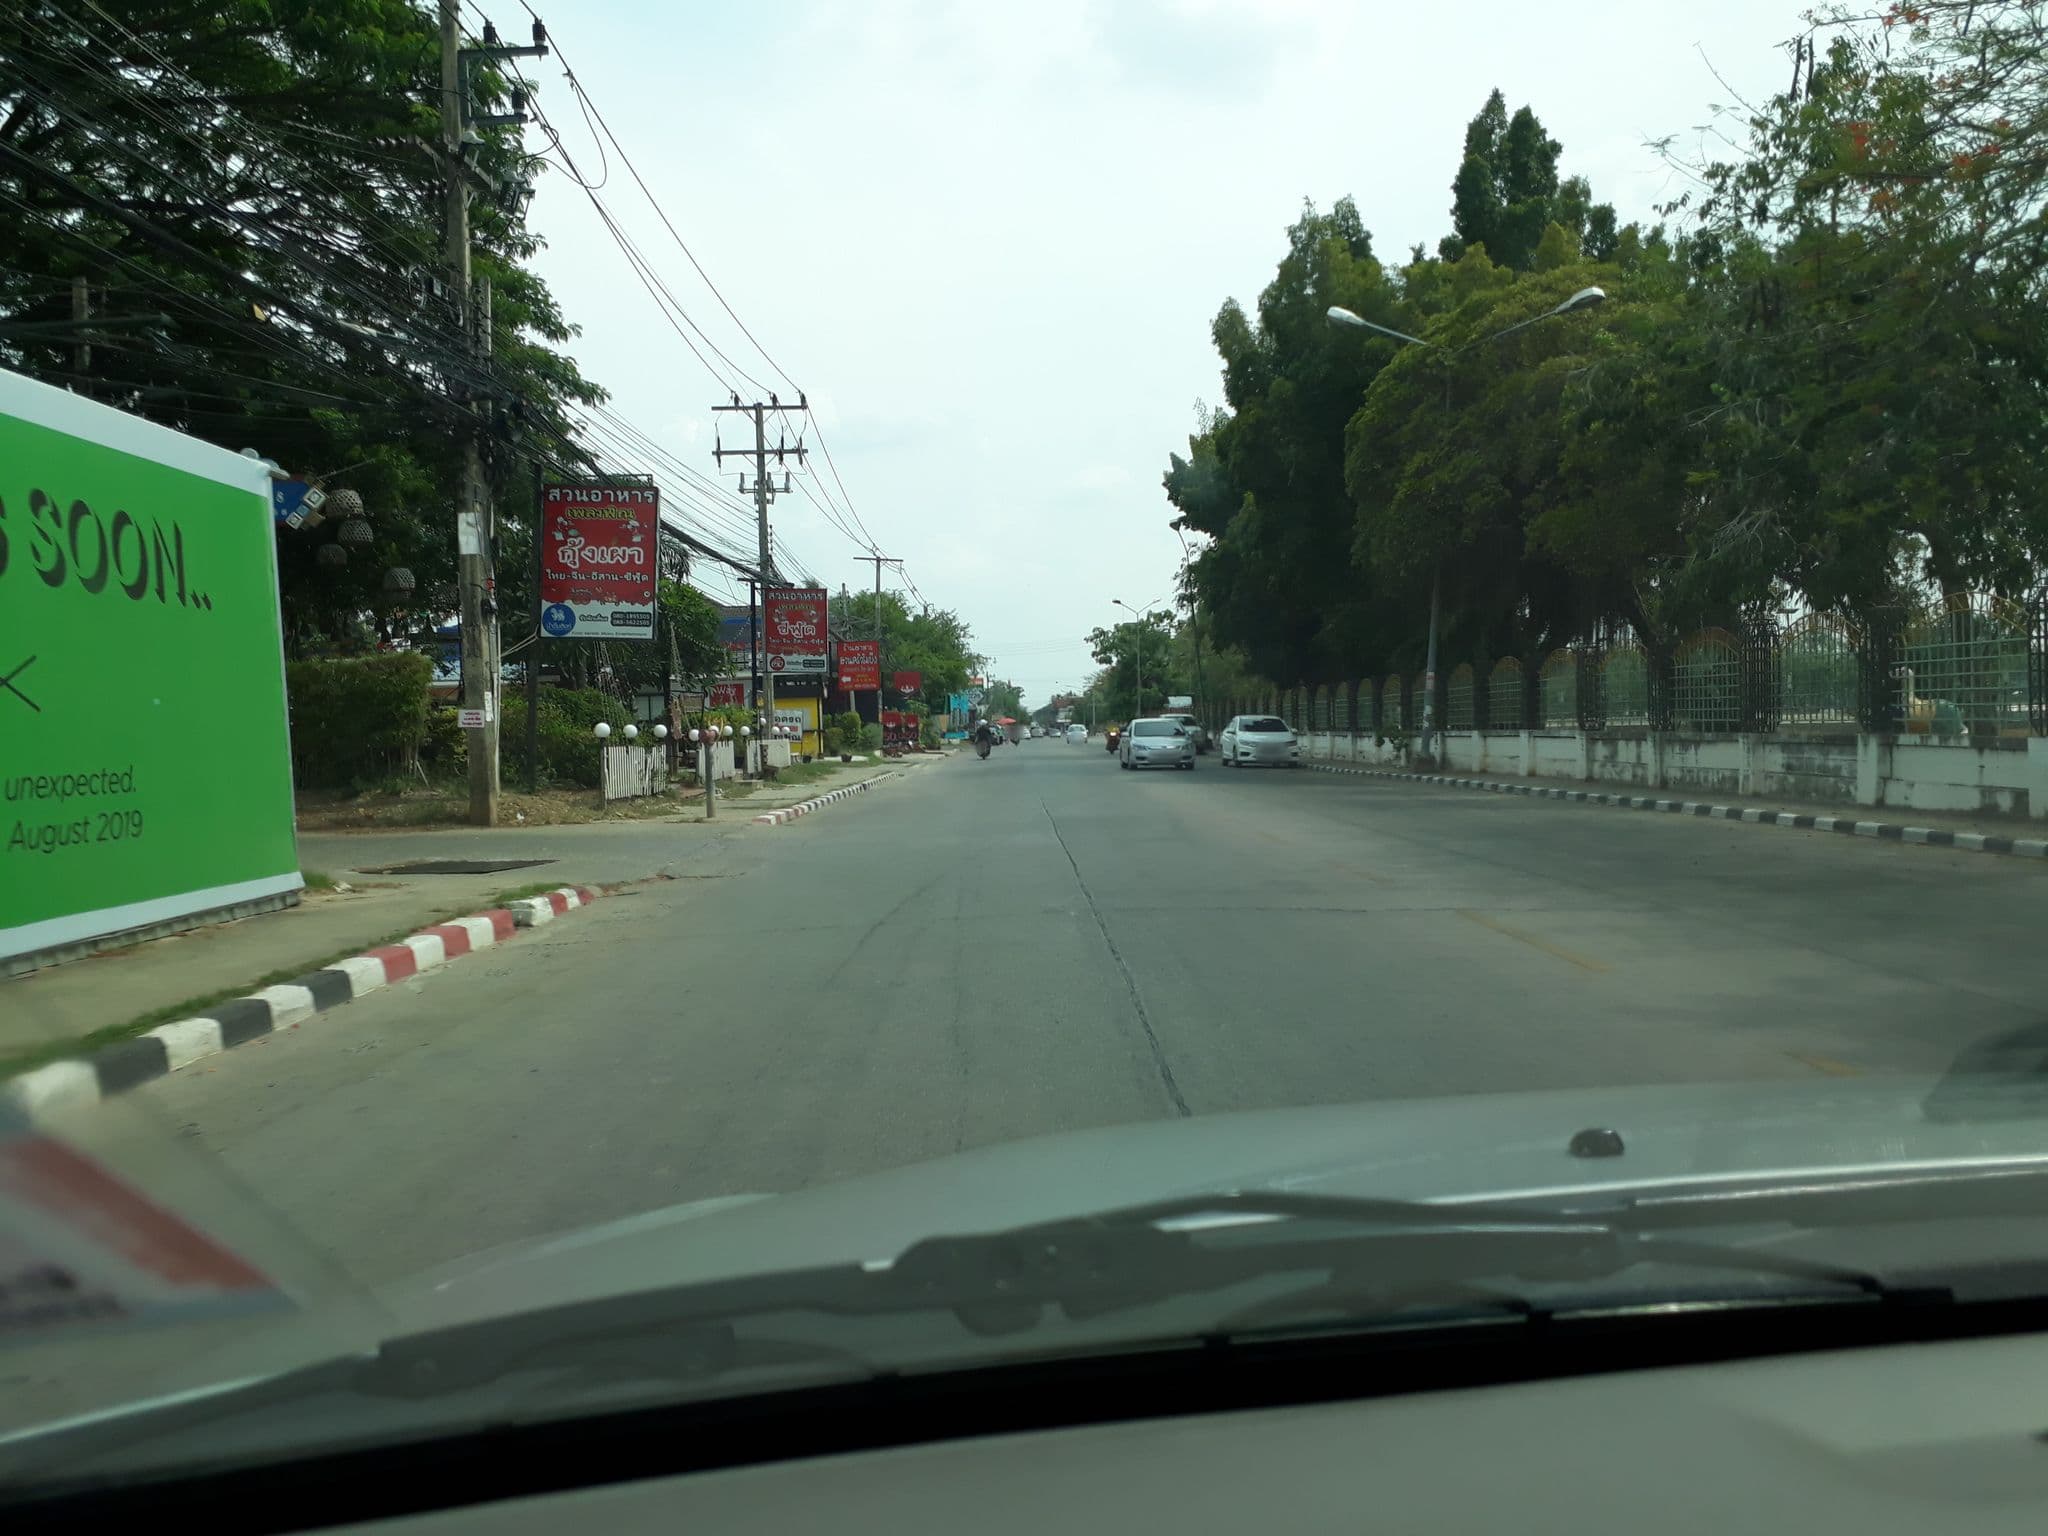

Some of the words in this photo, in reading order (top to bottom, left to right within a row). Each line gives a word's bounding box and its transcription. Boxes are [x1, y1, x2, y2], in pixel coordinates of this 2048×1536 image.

[548, 487, 654, 503] สวนอาหาร
[557, 537, 644, 569] กุ้งเผา
[5, 764, 137, 804] unexpected.
[7, 815, 91, 854] August
[96, 809, 144, 842] 2019
